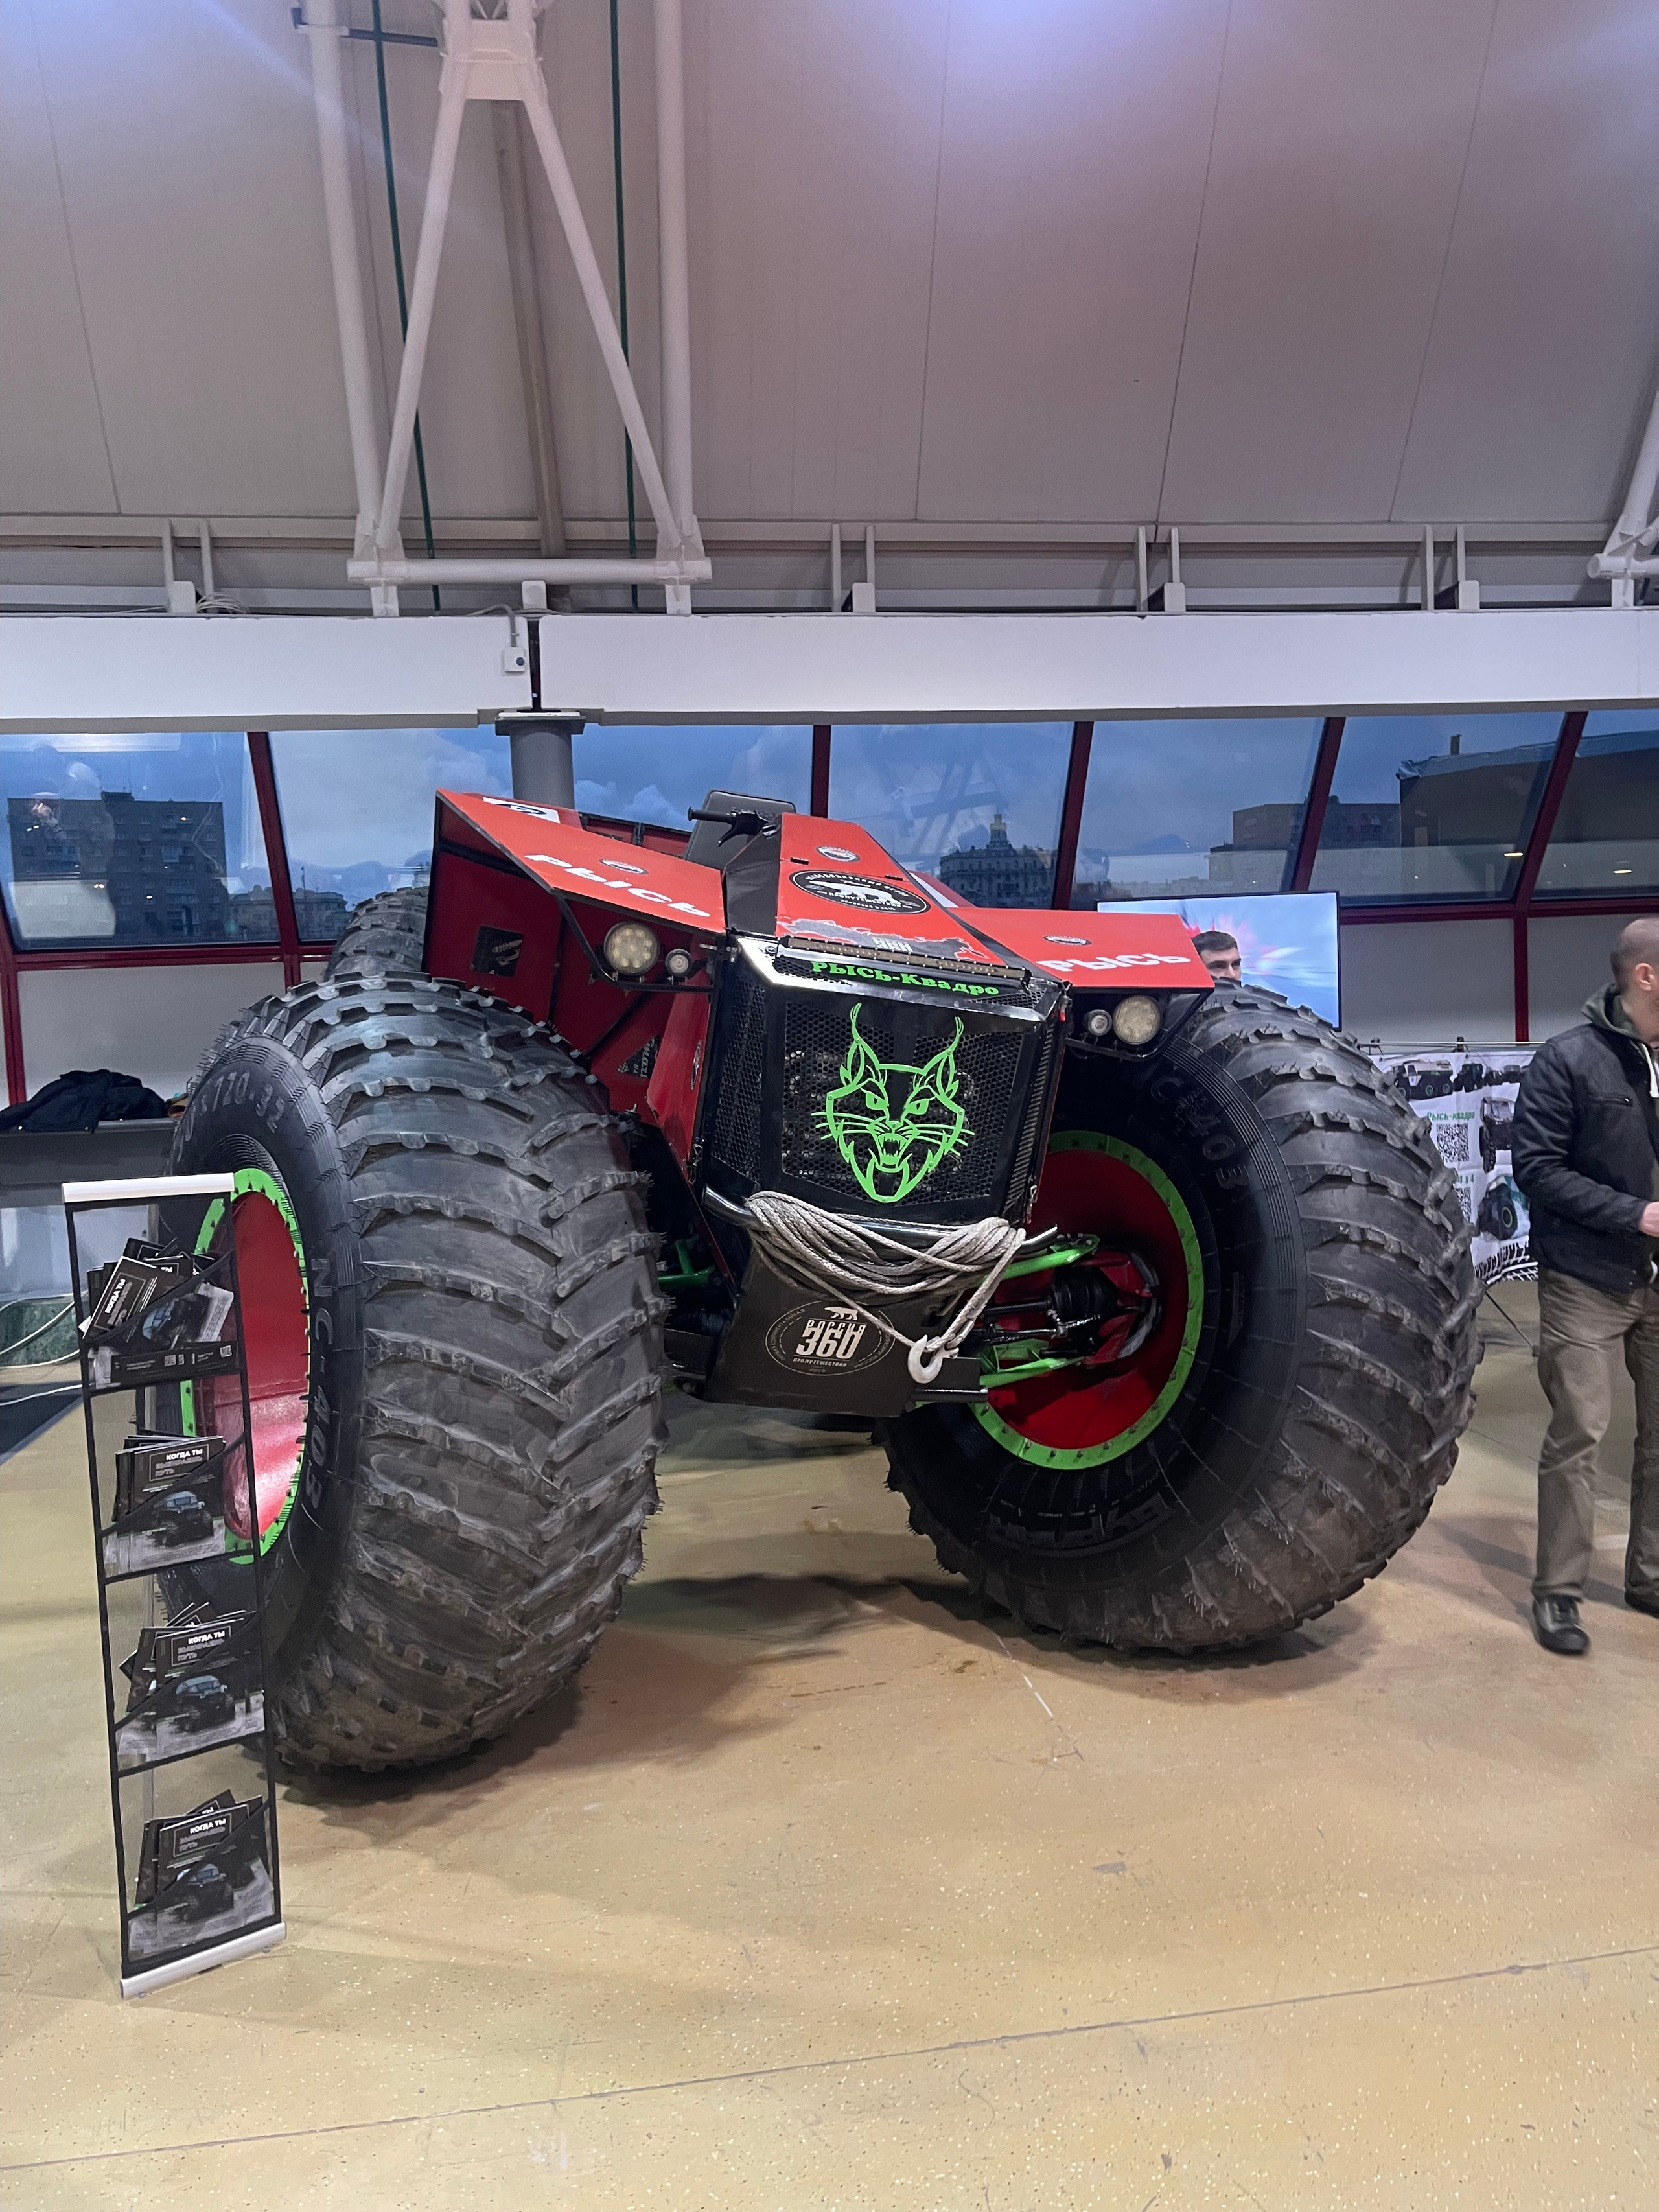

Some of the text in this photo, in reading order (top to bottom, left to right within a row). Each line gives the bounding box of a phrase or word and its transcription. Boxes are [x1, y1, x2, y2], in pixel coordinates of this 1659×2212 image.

[524, 854, 710, 917] РЫСЬ
[1035, 953, 1191, 972] РЫСЬ
[811, 961, 999, 995] РЫСЬ-Квадро
[804, 1319, 867, 1334] РОССИЯ
[795, 1326, 863, 1360] 360
[793, 1358, 848, 1368] ПРОПУТЕШЕСТВИЯ
[166, 1451, 191, 1461] КОГДА
[188, 1633, 213, 1644] КОГДА
[190, 1818, 226, 1834] КОГДА ТЫ
